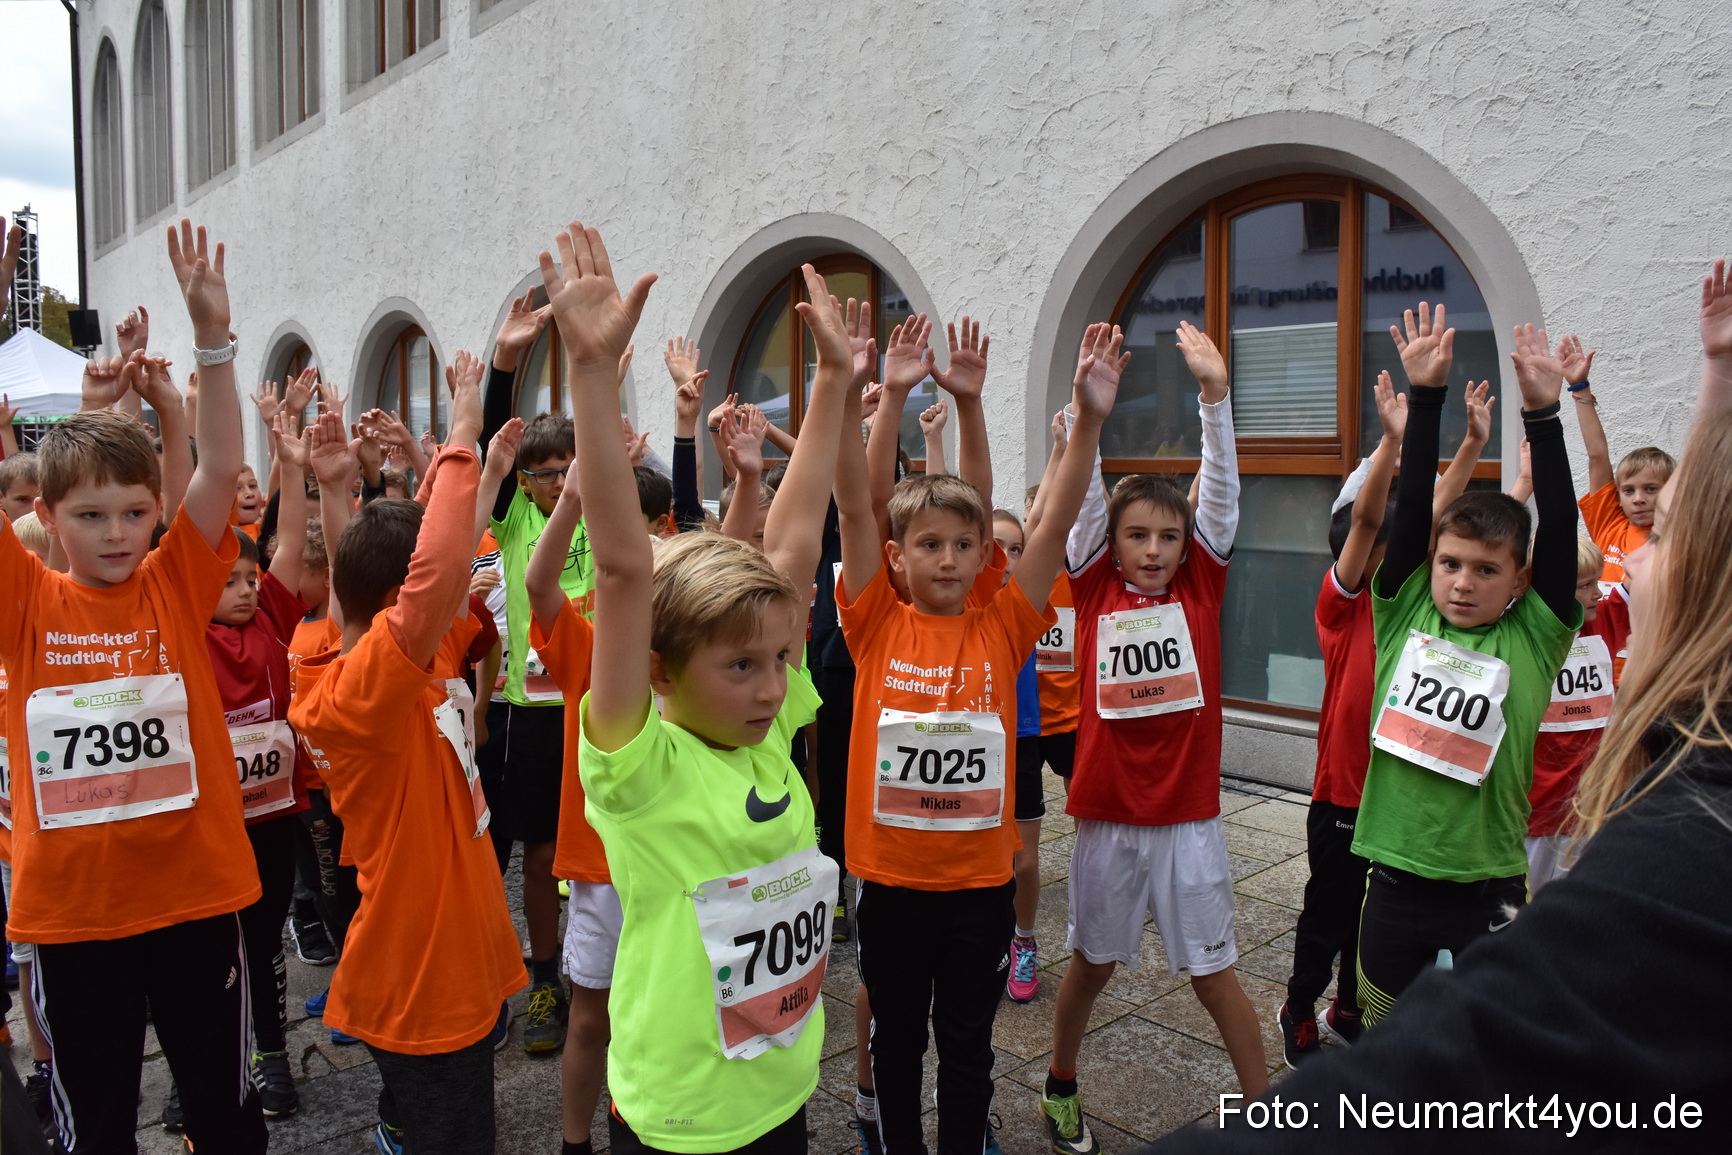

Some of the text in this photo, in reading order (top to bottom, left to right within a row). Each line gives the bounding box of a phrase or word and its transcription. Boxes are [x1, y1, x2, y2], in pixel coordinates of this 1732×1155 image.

[1125, 616, 1161, 630] BOCK
[46, 631, 138, 646] Neumarkter
[45, 650, 121, 668] Stadtlauf
[1109, 637, 1181, 677] 7006
[1438, 652, 1484, 677] BOCK
[884, 676, 949, 697] Stadtlauf
[1557, 665, 1602, 696] 045
[90, 690, 143, 706] BOCK
[1130, 685, 1165, 699] Lukas
[228, 709, 255, 724] DEHN
[1563, 705, 1591, 716] Jonas
[928, 723, 972, 733] BOCK
[54, 718, 170, 770] 7398
[897, 746, 986, 784] 7025
[881, 774, 890, 782] B6
[64, 782, 130, 804] Lukas
[920, 796, 961, 810] Niklas
[1336, 820, 1354, 830] Emre
[767, 866, 811, 897] BOCK
[734, 900, 826, 987] 7099
[721, 988, 733, 1000] B6
